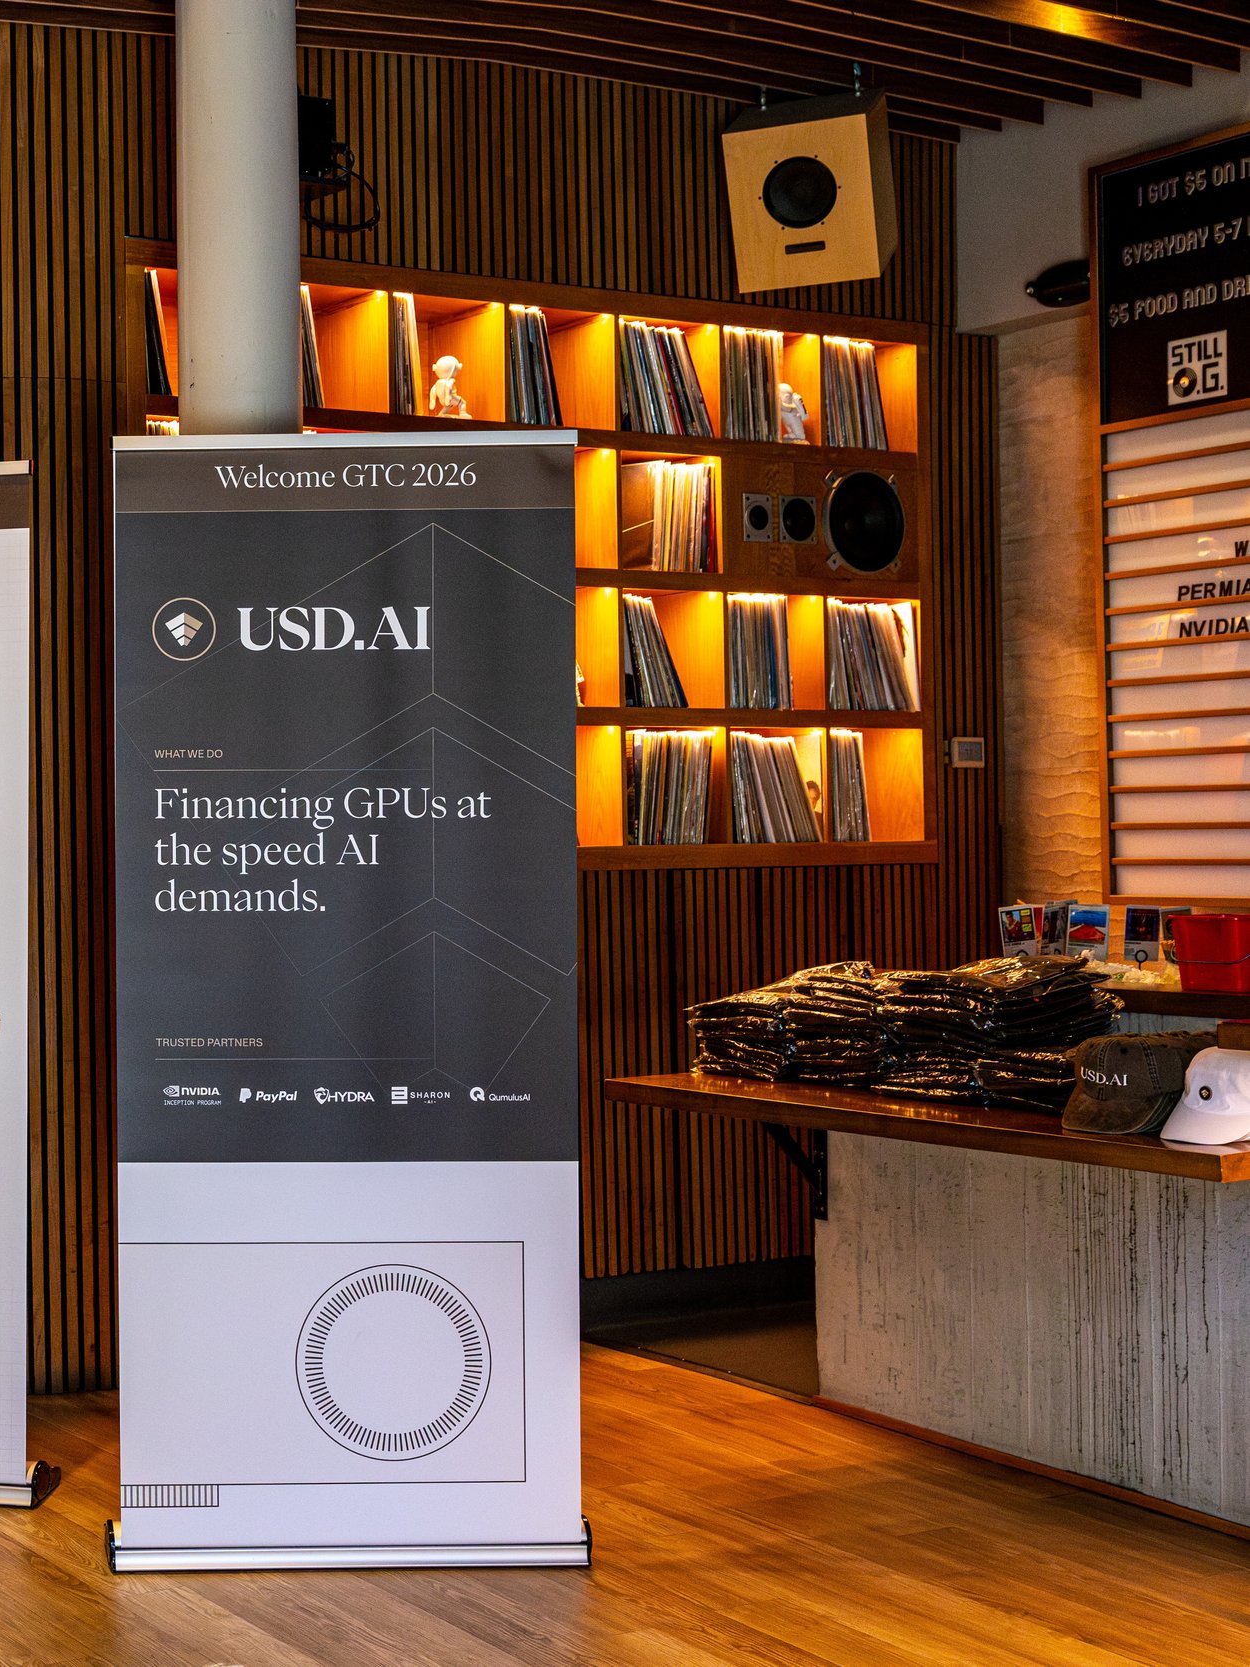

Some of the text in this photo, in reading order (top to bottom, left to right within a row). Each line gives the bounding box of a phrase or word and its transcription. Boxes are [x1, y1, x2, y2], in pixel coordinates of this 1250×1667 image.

[1149, 176, 1179, 204] GOT
[1185, 168, 1207, 196] $5
[1213, 217, 1243, 244] 5-7
[1109, 303, 1129, 327] $5
[1134, 292, 1178, 320] FOOD
[1182, 282, 1217, 310] AND
[1172, 337, 1222, 367] STILL
[215, 463, 476, 488] Welcome GTC 2026
[237, 605, 431, 653] USD.AI
[1179, 616, 1250, 638] NVIDIA
[155, 749, 223, 758] WHAT WE DO
[154, 786, 491, 829] Financing GPUs at
[154, 833, 380, 875] the speed AI
[154, 879, 327, 912] demands.
[156, 1038, 262, 1047] TRUSTED PARTNERS
[1081, 1066, 1128, 1086] USD.AI
[256, 1091, 297, 1103] PayPal
[328, 1091, 375, 1102] HYDRA
[489, 1093, 530, 1101] QumulusAI
